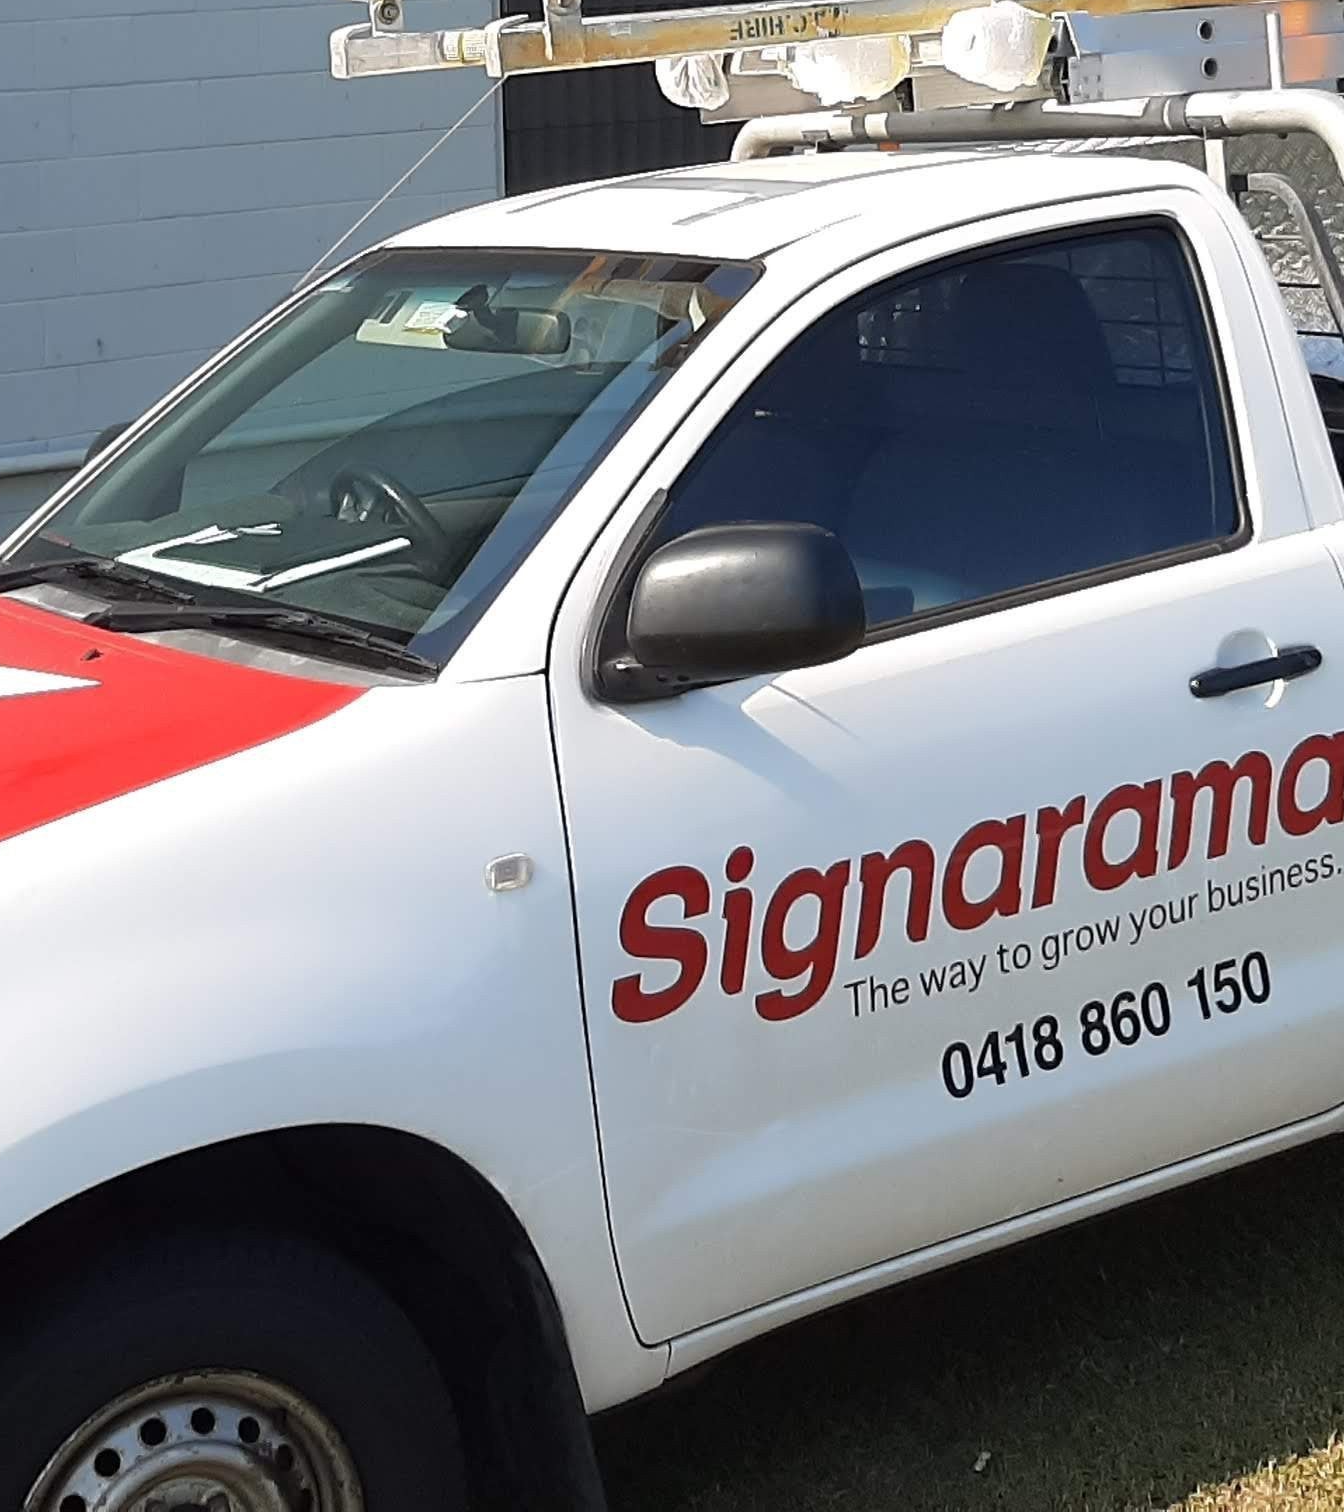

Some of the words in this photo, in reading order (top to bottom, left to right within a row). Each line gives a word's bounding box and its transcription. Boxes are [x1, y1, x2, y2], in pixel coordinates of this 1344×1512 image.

[844, 978, 912, 1019] The
[919, 951, 988, 997] way
[996, 940, 1033, 976] to
[1041, 919, 1121, 971] grow
[1128, 894, 1200, 946] your
[1206, 851, 1343, 913] business.
[941, 1013, 1064, 1100] 0418
[1080, 980, 1172, 1058] 860
[1186, 949, 1272, 1022] 150
